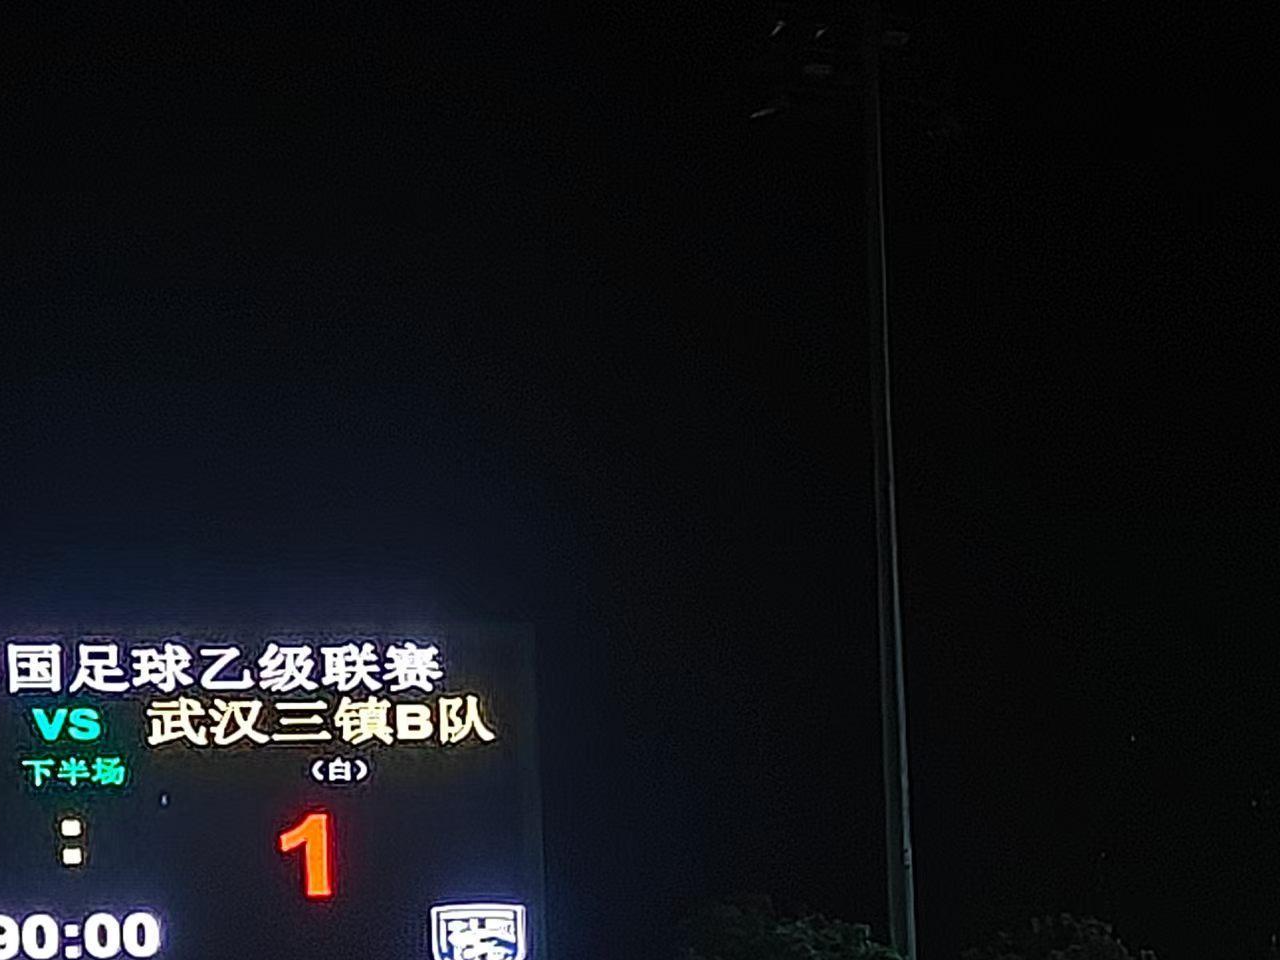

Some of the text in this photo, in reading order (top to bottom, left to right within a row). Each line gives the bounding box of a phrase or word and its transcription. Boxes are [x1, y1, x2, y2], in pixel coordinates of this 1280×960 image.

[32, 707, 102, 741] VS
[145, 697, 496, 746] 武汉三镇B队
[22, 757, 126, 786] 下半场
[311, 759, 370, 783] (白)
[279, 812, 331, 897] 1
